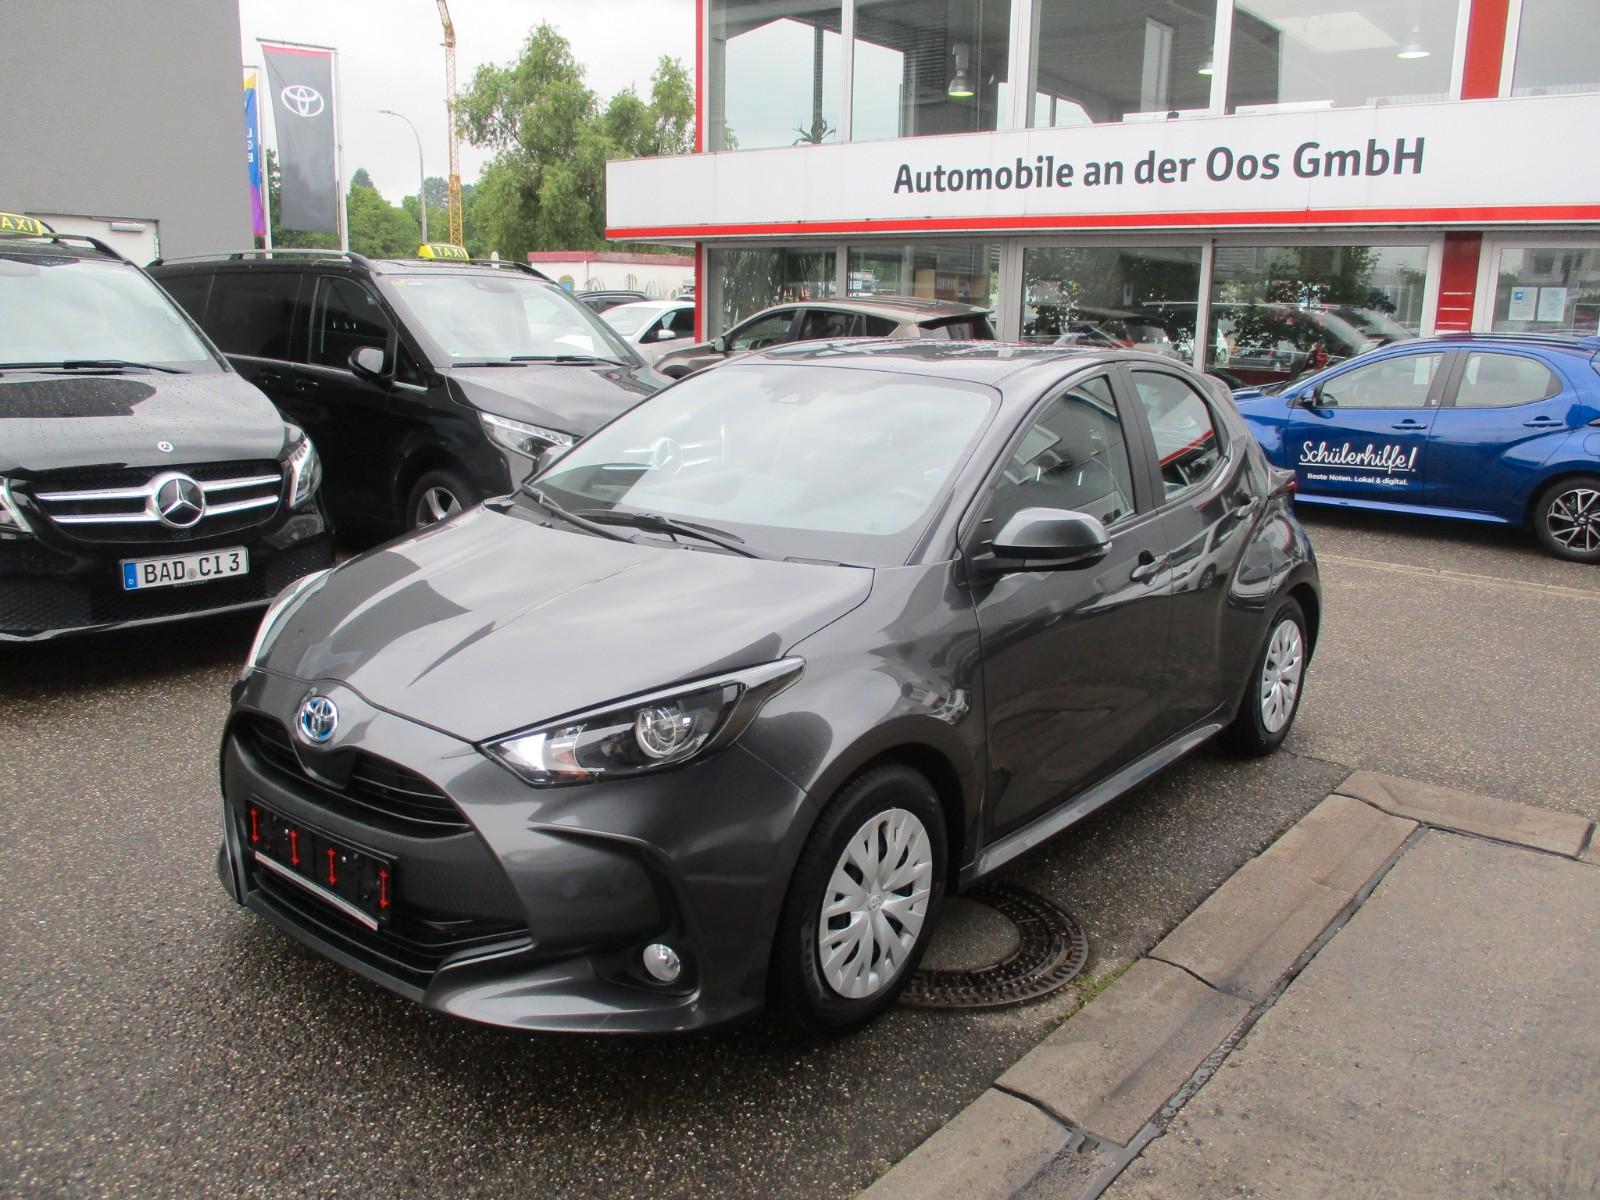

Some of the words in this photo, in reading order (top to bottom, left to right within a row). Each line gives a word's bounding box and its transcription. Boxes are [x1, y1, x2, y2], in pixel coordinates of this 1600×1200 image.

[893, 155, 1074, 194] Automobile
[1083, 160, 1124, 187] an
[1134, 150, 1196, 185] der
[1206, 145, 1280, 182] Oos
[1293, 136, 1425, 179] GmbH
[0, 215, 33, 232] AXI
[434, 246, 464, 257] TAXI
[1299, 441, 1418, 474] Schülerhilfe!
[1329, 474, 1353, 482] Noten.
[1354, 476, 1375, 484] Lokal
[1382, 478, 1408, 486] digital.
[144, 560, 185, 584] BAD
[229, 553, 240, 572] 3
